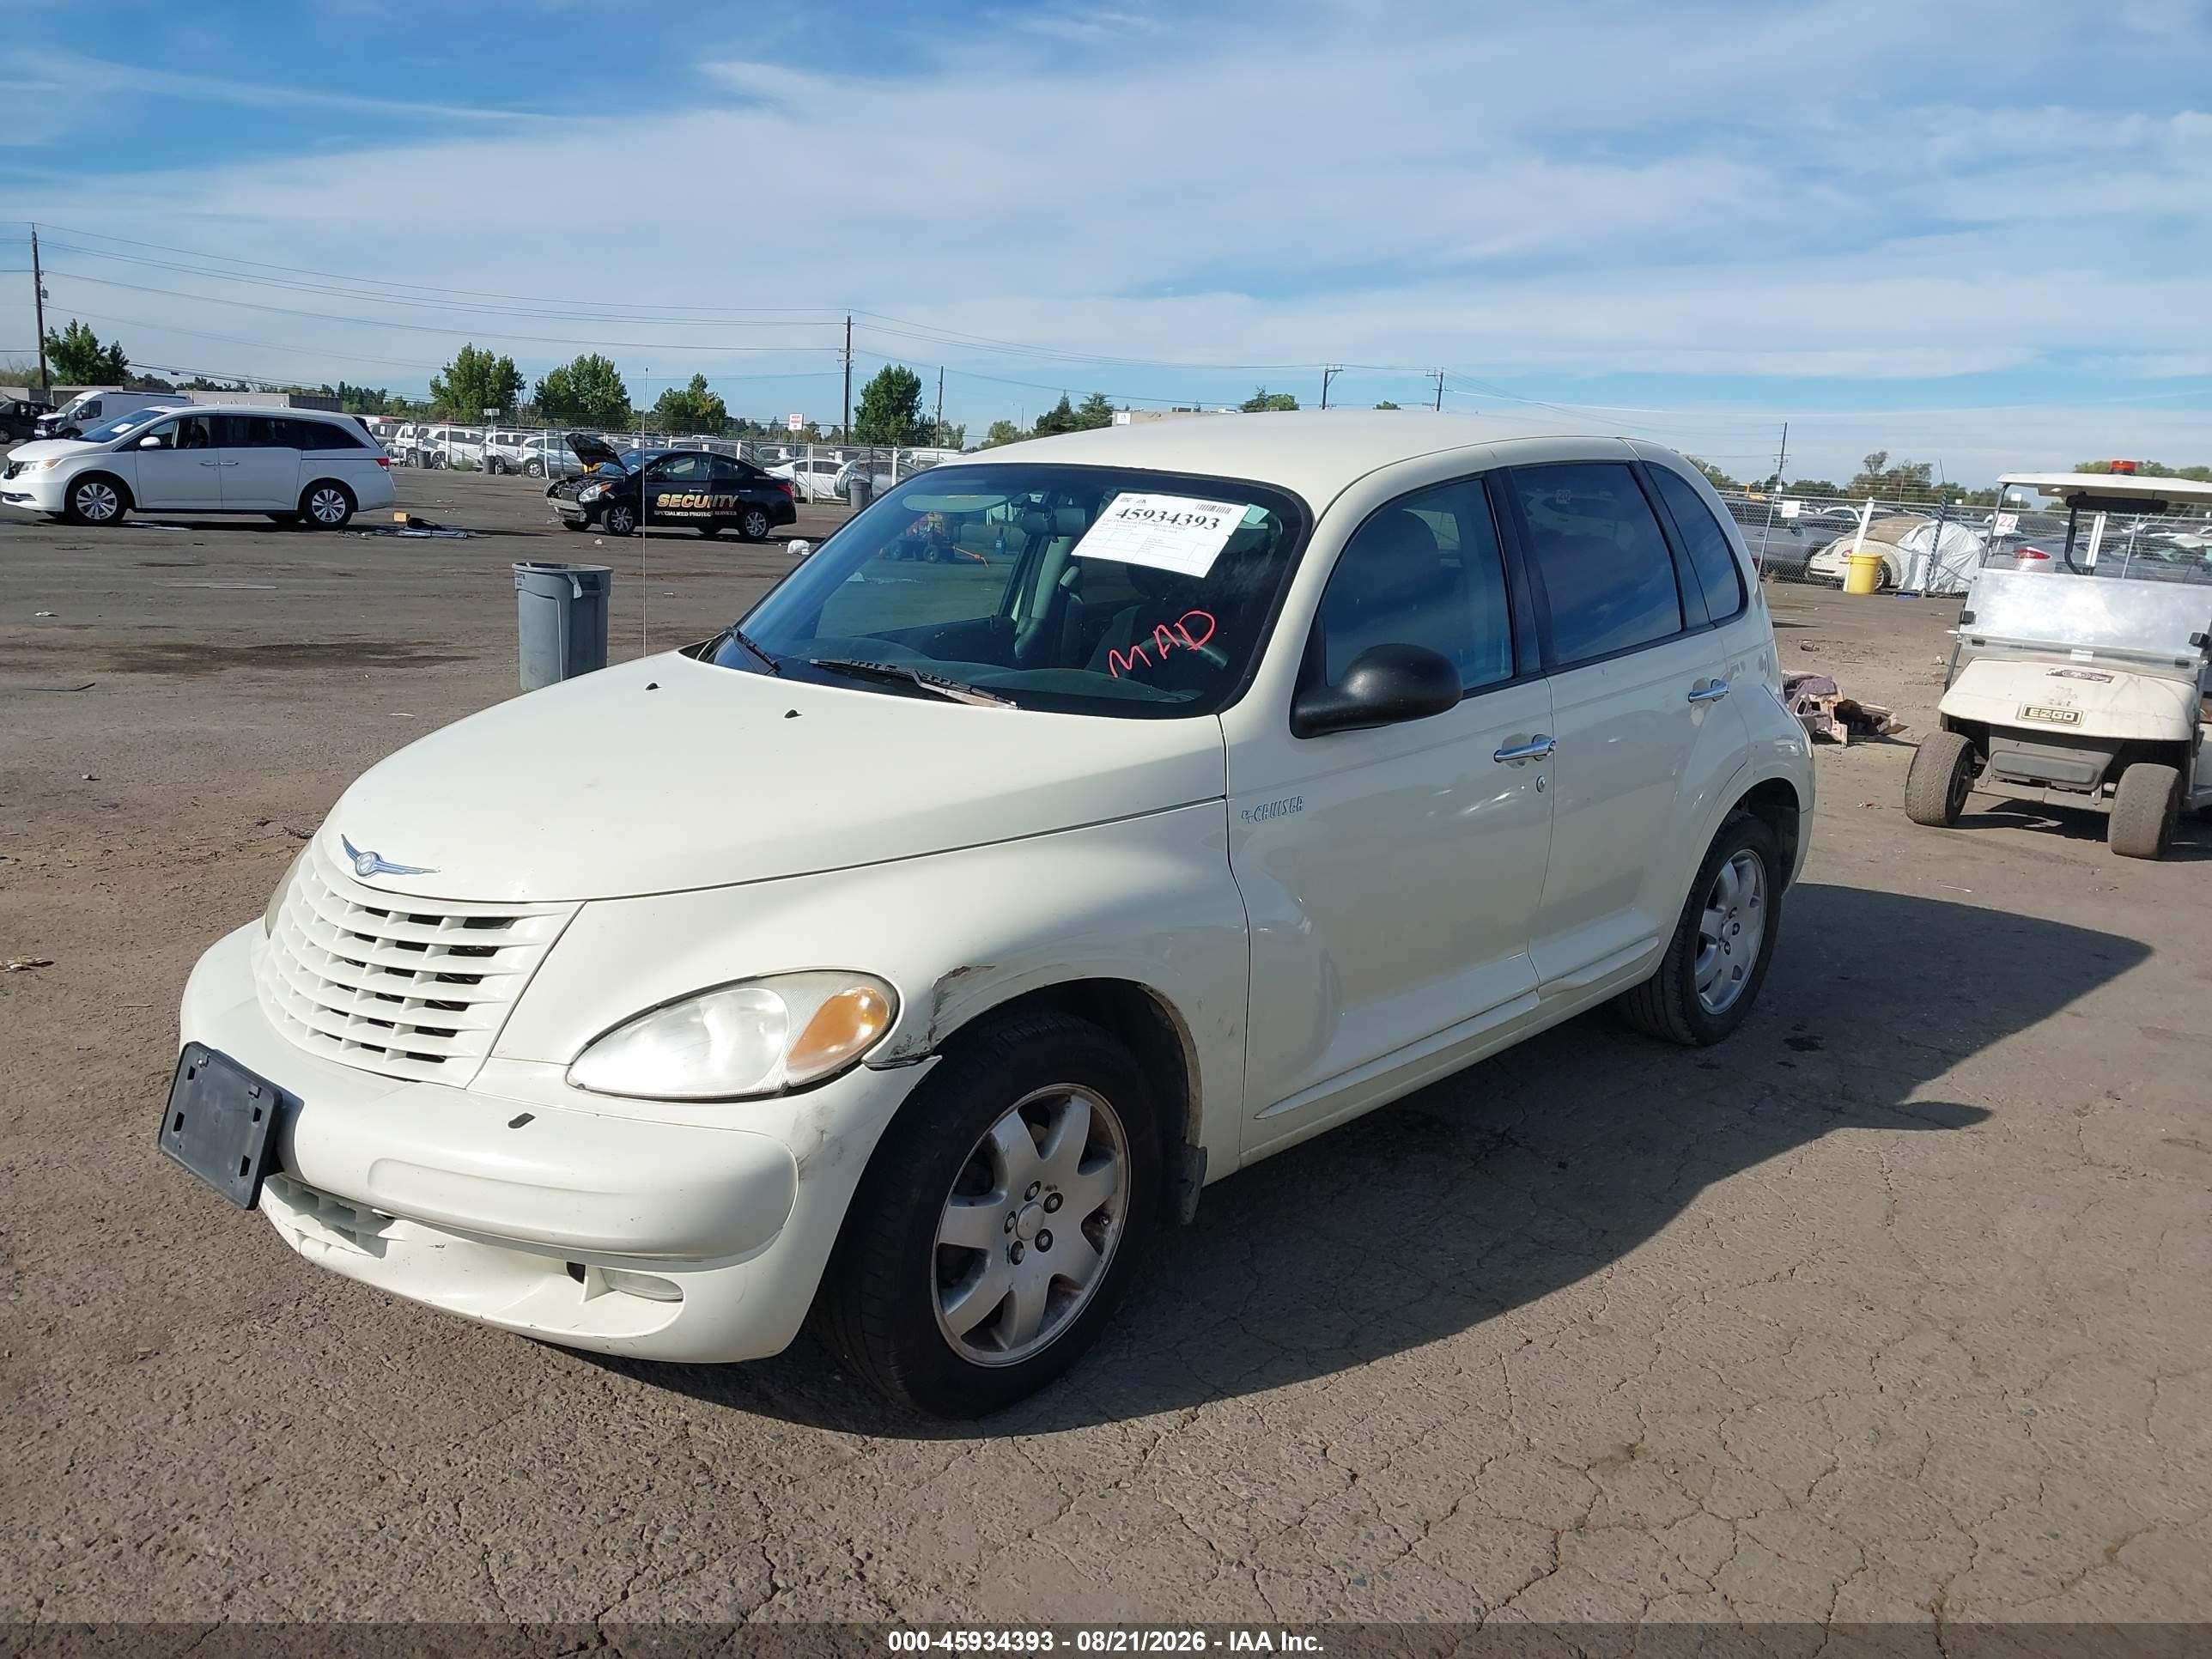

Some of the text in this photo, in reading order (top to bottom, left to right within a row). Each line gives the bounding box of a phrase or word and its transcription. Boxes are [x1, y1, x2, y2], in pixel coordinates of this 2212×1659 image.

[656, 494, 738, 508] SECURITY
[1115, 507, 1221, 531] 45934393
[1998, 515, 2015, 528] 22
[1108, 610, 1216, 678] MAD
[1254, 795, 1304, 823] CRUISER
